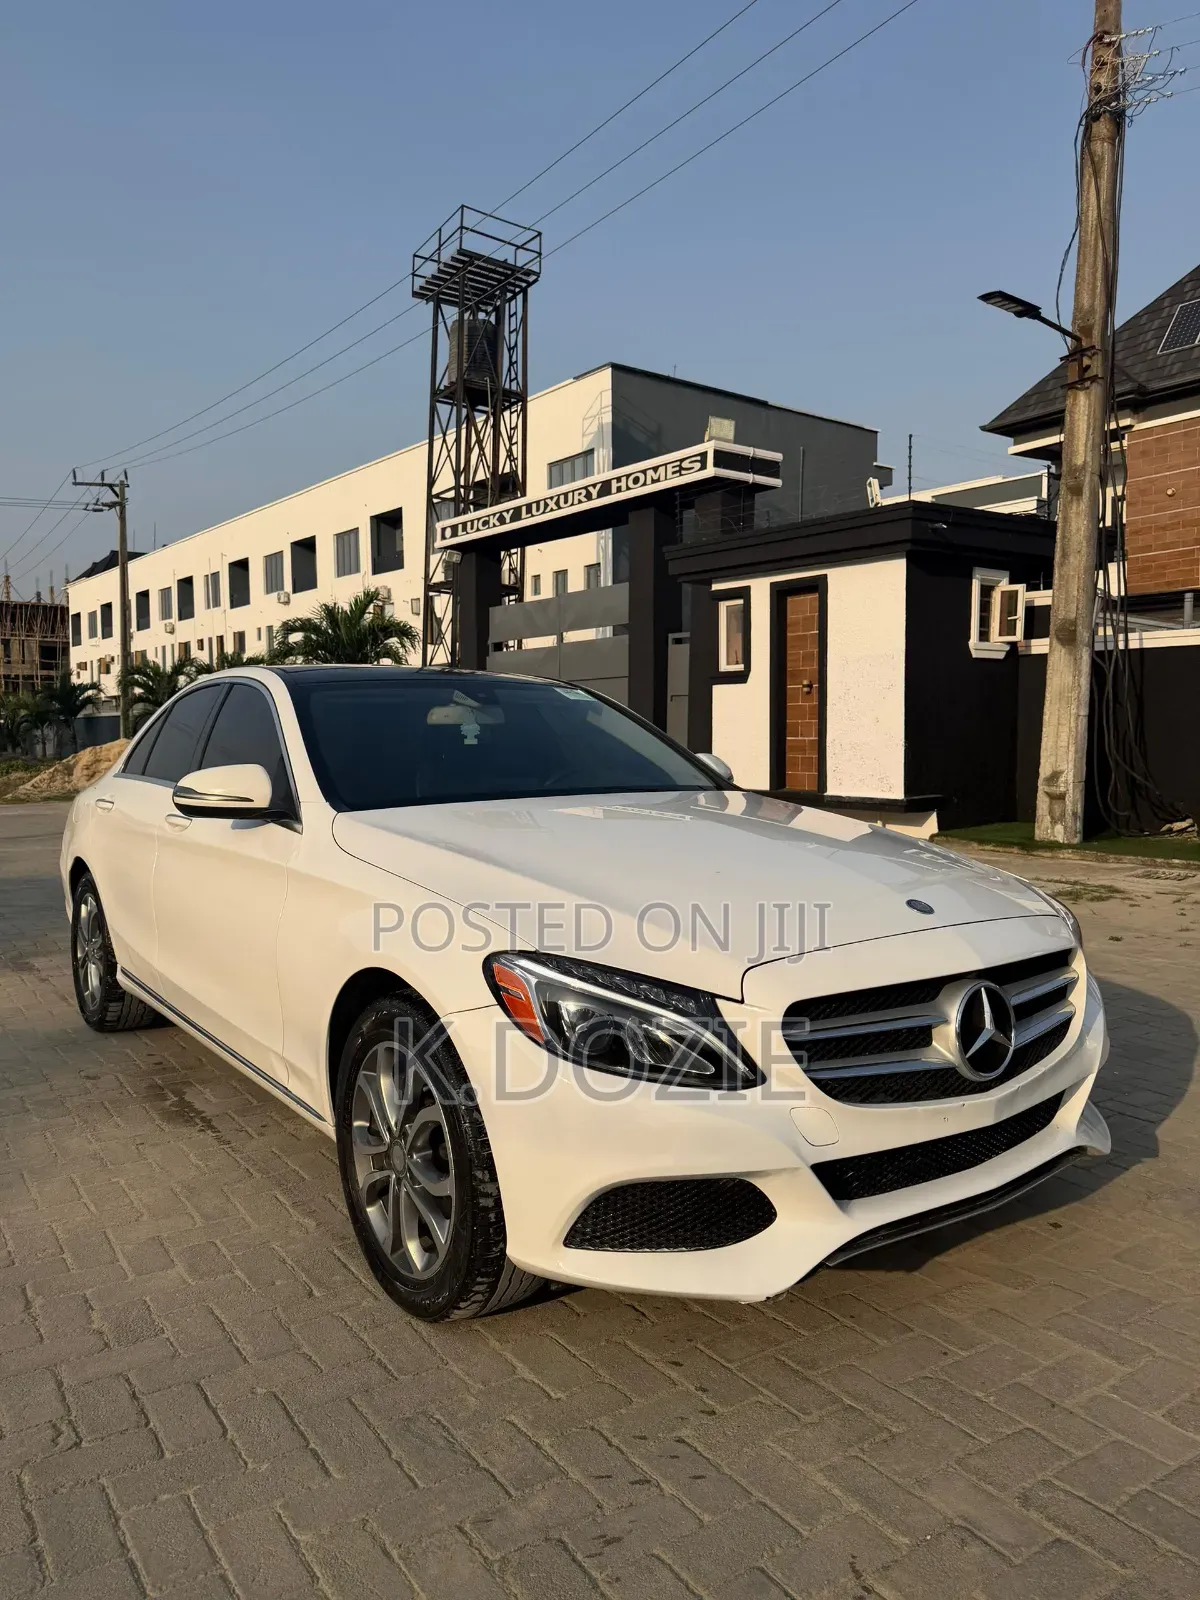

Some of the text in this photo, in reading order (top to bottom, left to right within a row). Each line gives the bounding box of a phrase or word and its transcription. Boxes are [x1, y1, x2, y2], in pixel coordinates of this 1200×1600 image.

[457, 456, 702, 537] LUCKY LUXURY HOMES
